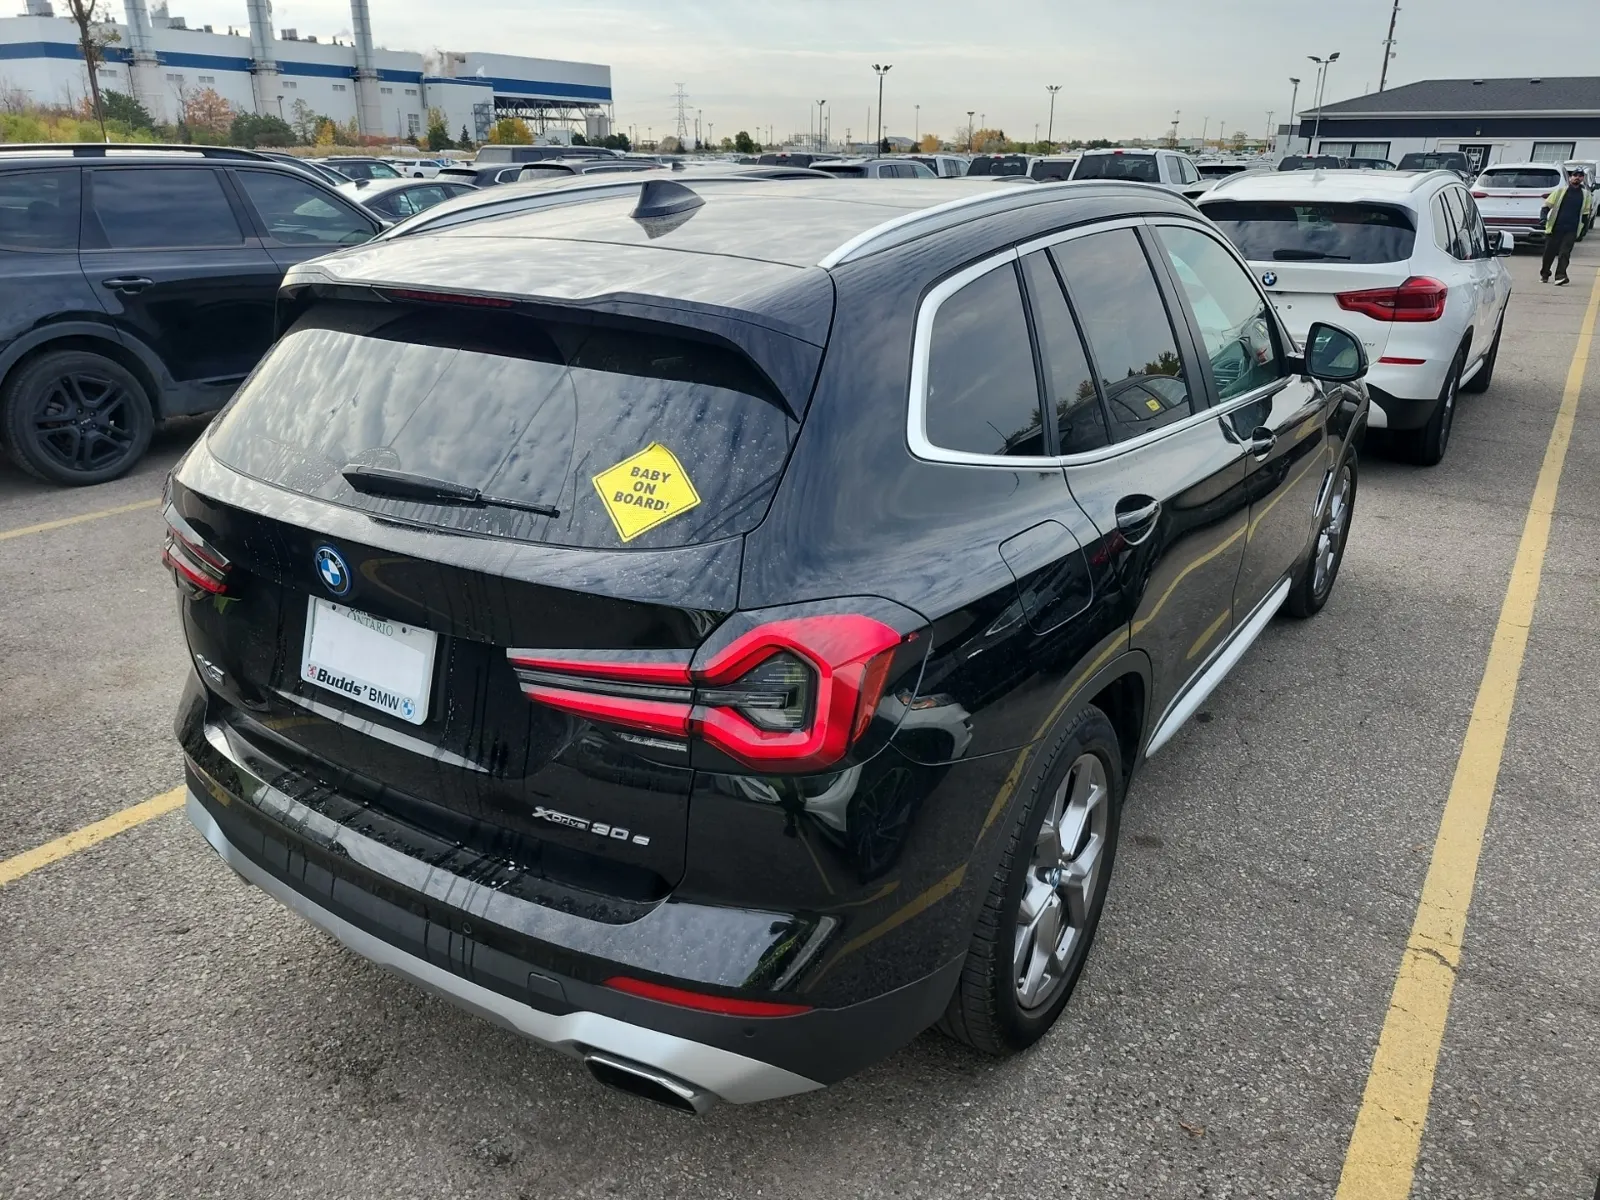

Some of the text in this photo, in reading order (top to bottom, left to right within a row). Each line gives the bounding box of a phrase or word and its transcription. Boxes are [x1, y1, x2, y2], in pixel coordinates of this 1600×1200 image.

[630, 466, 671, 483] BABY
[632, 481, 657, 495] ON
[613, 491, 670, 513] BOARD!
[368, 687, 400, 710] BMW
